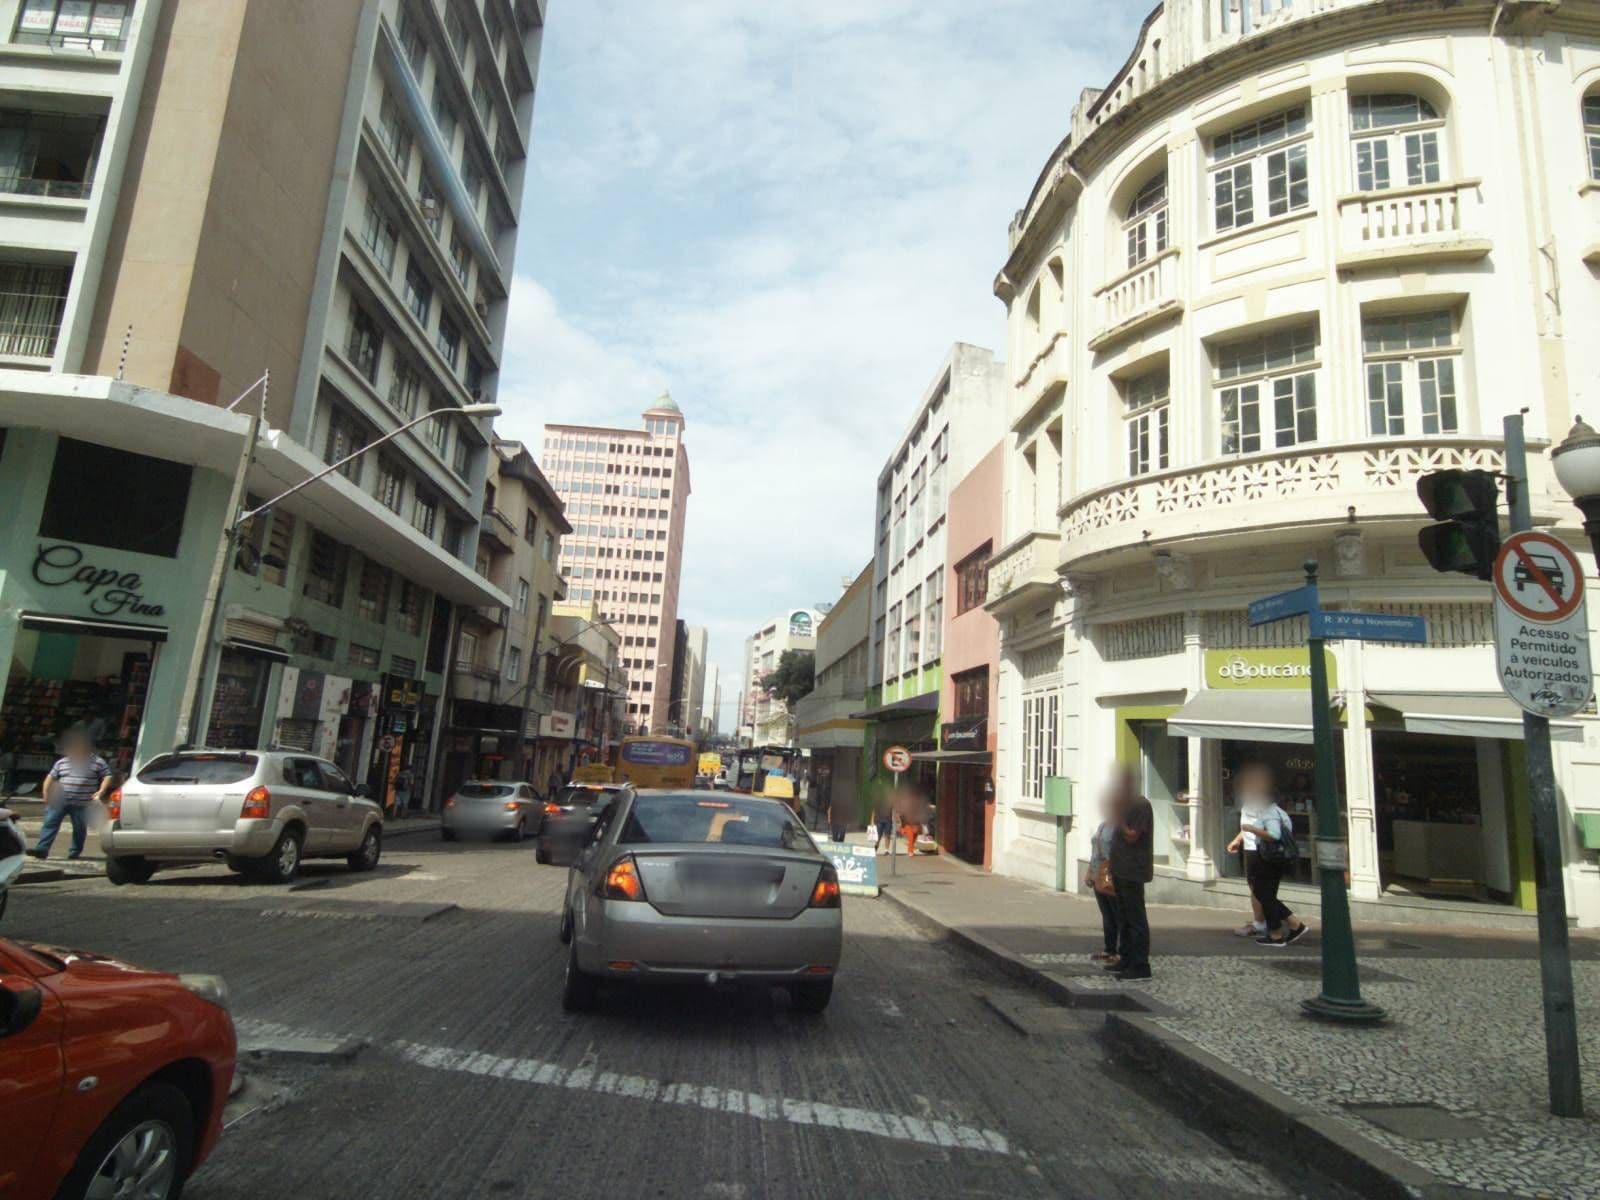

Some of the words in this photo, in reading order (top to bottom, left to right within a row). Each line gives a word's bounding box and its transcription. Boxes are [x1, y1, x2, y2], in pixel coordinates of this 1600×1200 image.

[32, 544, 143, 595] Capa
[90, 589, 164, 616] Fina
[1336, 616, 1350, 624] XV
[1352, 617, 1364, 625] de
[1366, 617, 1414, 627] Novembro
[1519, 625, 1570, 640] Acesso
[1510, 638, 1577, 655] Permitido
[1504, 666, 1588, 684] Autorizados
